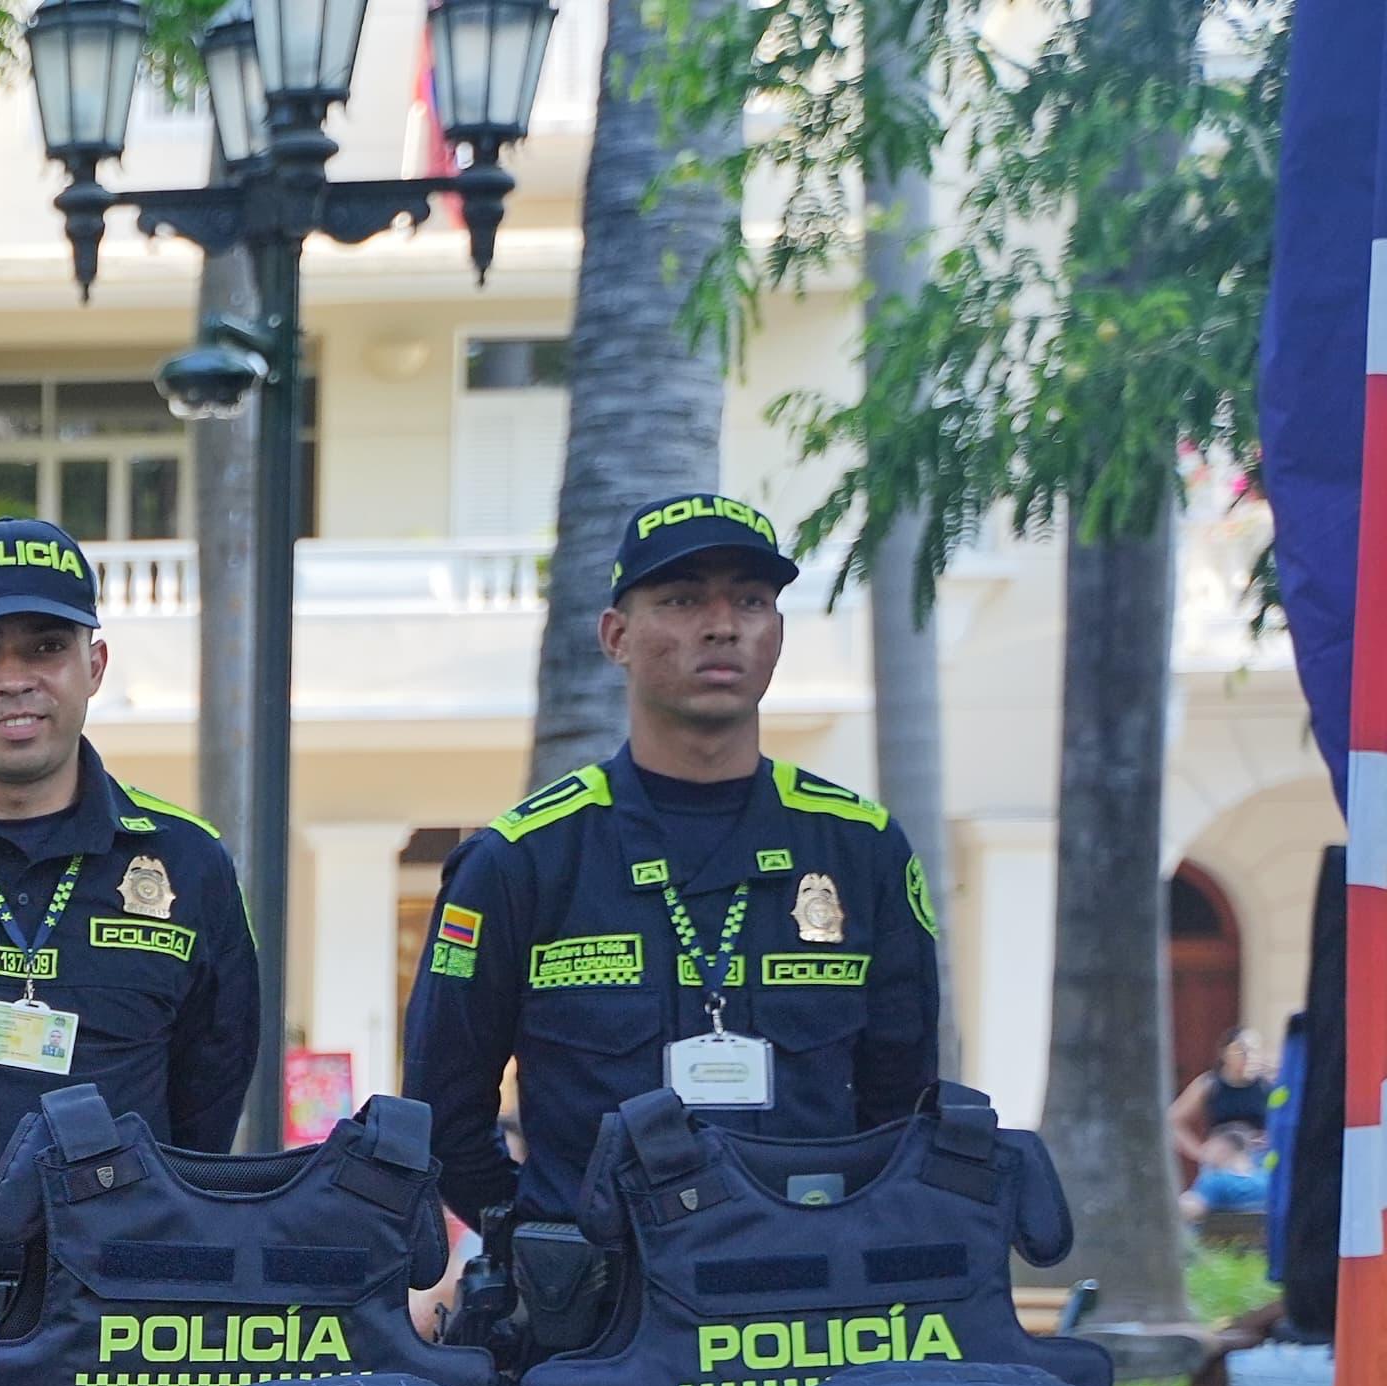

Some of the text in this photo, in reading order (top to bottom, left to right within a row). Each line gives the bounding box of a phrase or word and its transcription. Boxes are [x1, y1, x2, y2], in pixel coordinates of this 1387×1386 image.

[102, 928, 185, 953] POLICÍA
[0, 951, 50, 974] 13709
[574, 954, 635, 971] CORONADO
[775, 961, 859, 979] POLICÍA
[99, 1304, 351, 1363] POLICÍA
[698, 1303, 963, 1373] POLICÍA
